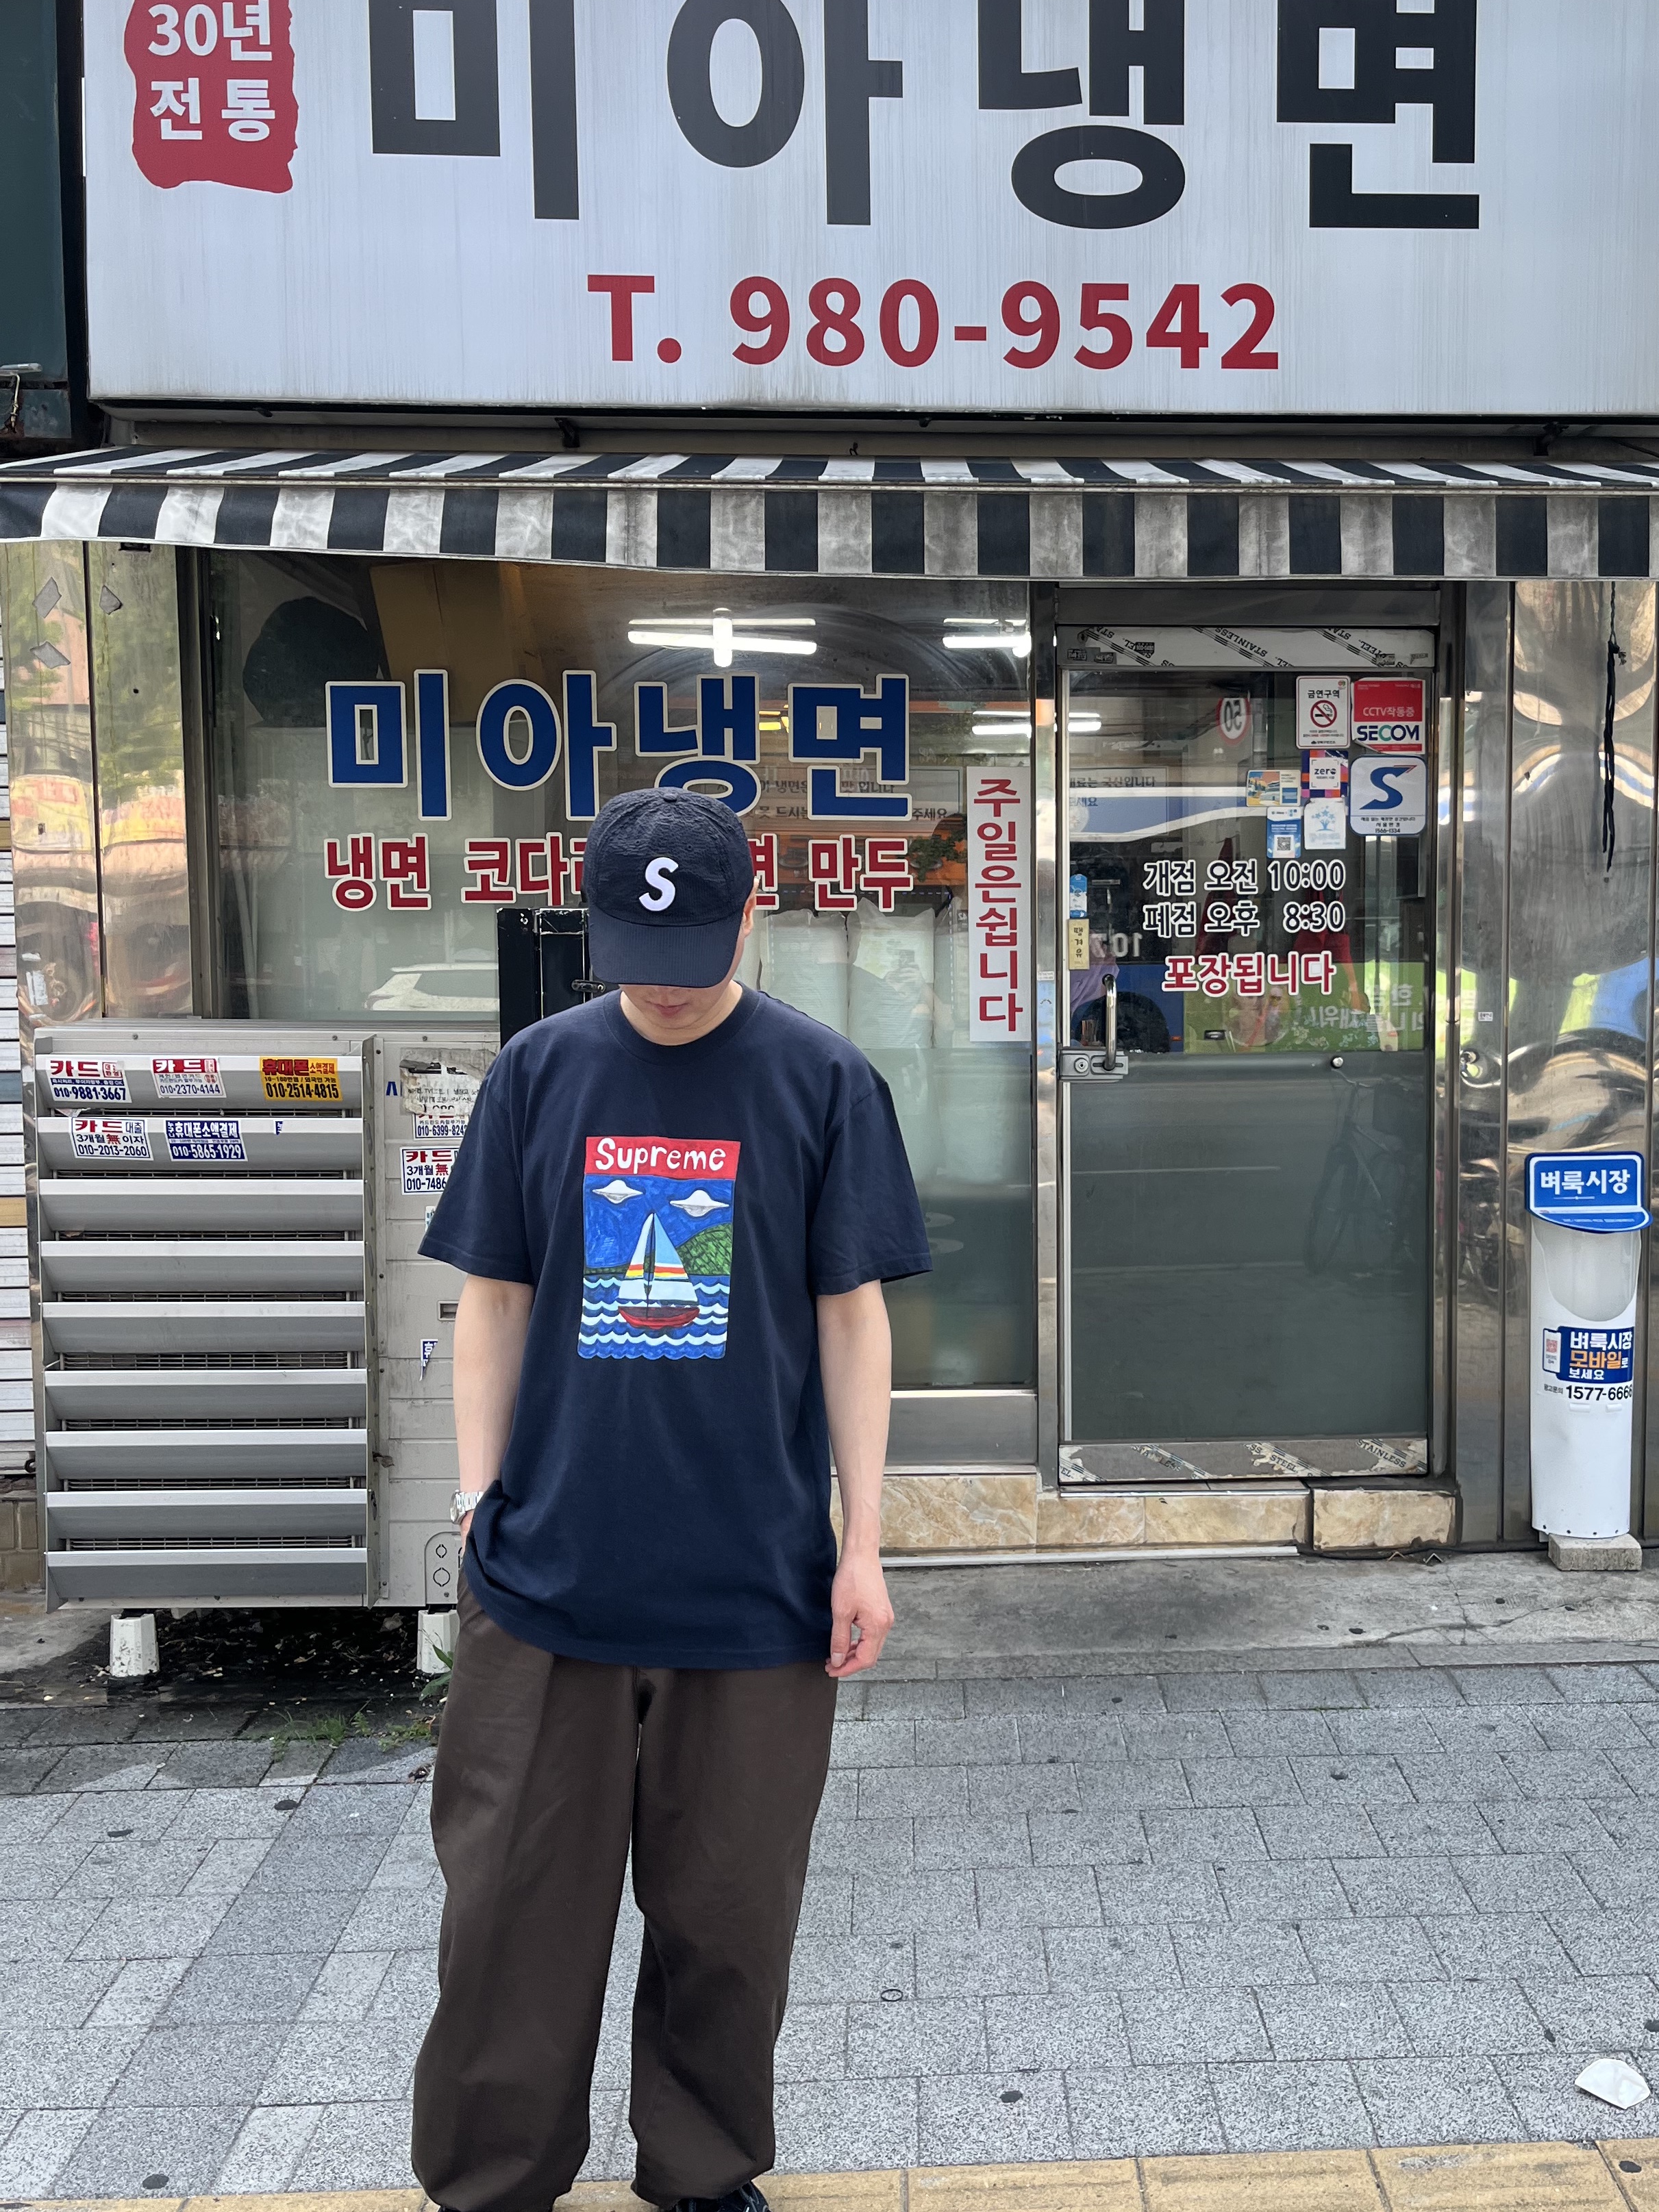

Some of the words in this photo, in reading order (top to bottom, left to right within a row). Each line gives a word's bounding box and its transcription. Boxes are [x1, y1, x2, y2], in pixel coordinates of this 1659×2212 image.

[147, 1, 273, 62] 30년
[587, 275, 682, 364] T.
[729, 276, 1279, 370] 980-9542
[1307, 689, 1340, 699] 금연구역
[1362, 706, 1415, 718] CCTV작동중
[1356, 724, 1420, 742] SECOM
[325, 668, 913, 821] 미아냉면
[1101, 776, 1156, 788] 국산입니다
[324, 833, 432, 911] 냉면
[807, 834, 914, 912] 만두
[1143, 859, 1196, 896] 개점
[1203, 858, 1259, 895] 오전
[1267, 859, 1346, 892] 10:00
[638, 857, 679, 912] S
[1143, 901, 1197, 938] 폐점
[1203, 900, 1260, 937] 오후
[1282, 901, 1346, 933] 8:30
[1161, 951, 1337, 998] 포장됩니다
[50, 1060, 101, 1077] 카드
[155, 1059, 202, 1072] 카드
[262, 1059, 310, 1076] 휴대폰
[75, 1120, 123, 1133] 카드
[77, 1134, 105, 1143] 3개월
[123, 1134, 145, 1144] 이자
[77, 1144, 147, 1157] 010-2013-2060
[406, 1150, 453, 1163] 카드
[595, 1137, 726, 1174] Supreme
[406, 1164, 434, 1176] 3개월
[1540, 1168, 1631, 1195] 벼룩시장
[1569, 1331, 1633, 1351] 벼룩시장
[1569, 1350, 1629, 1370] 모바일로
[1568, 1367, 1605, 1381] 보세요
[1565, 1383, 1632, 1401] 1577-6666
